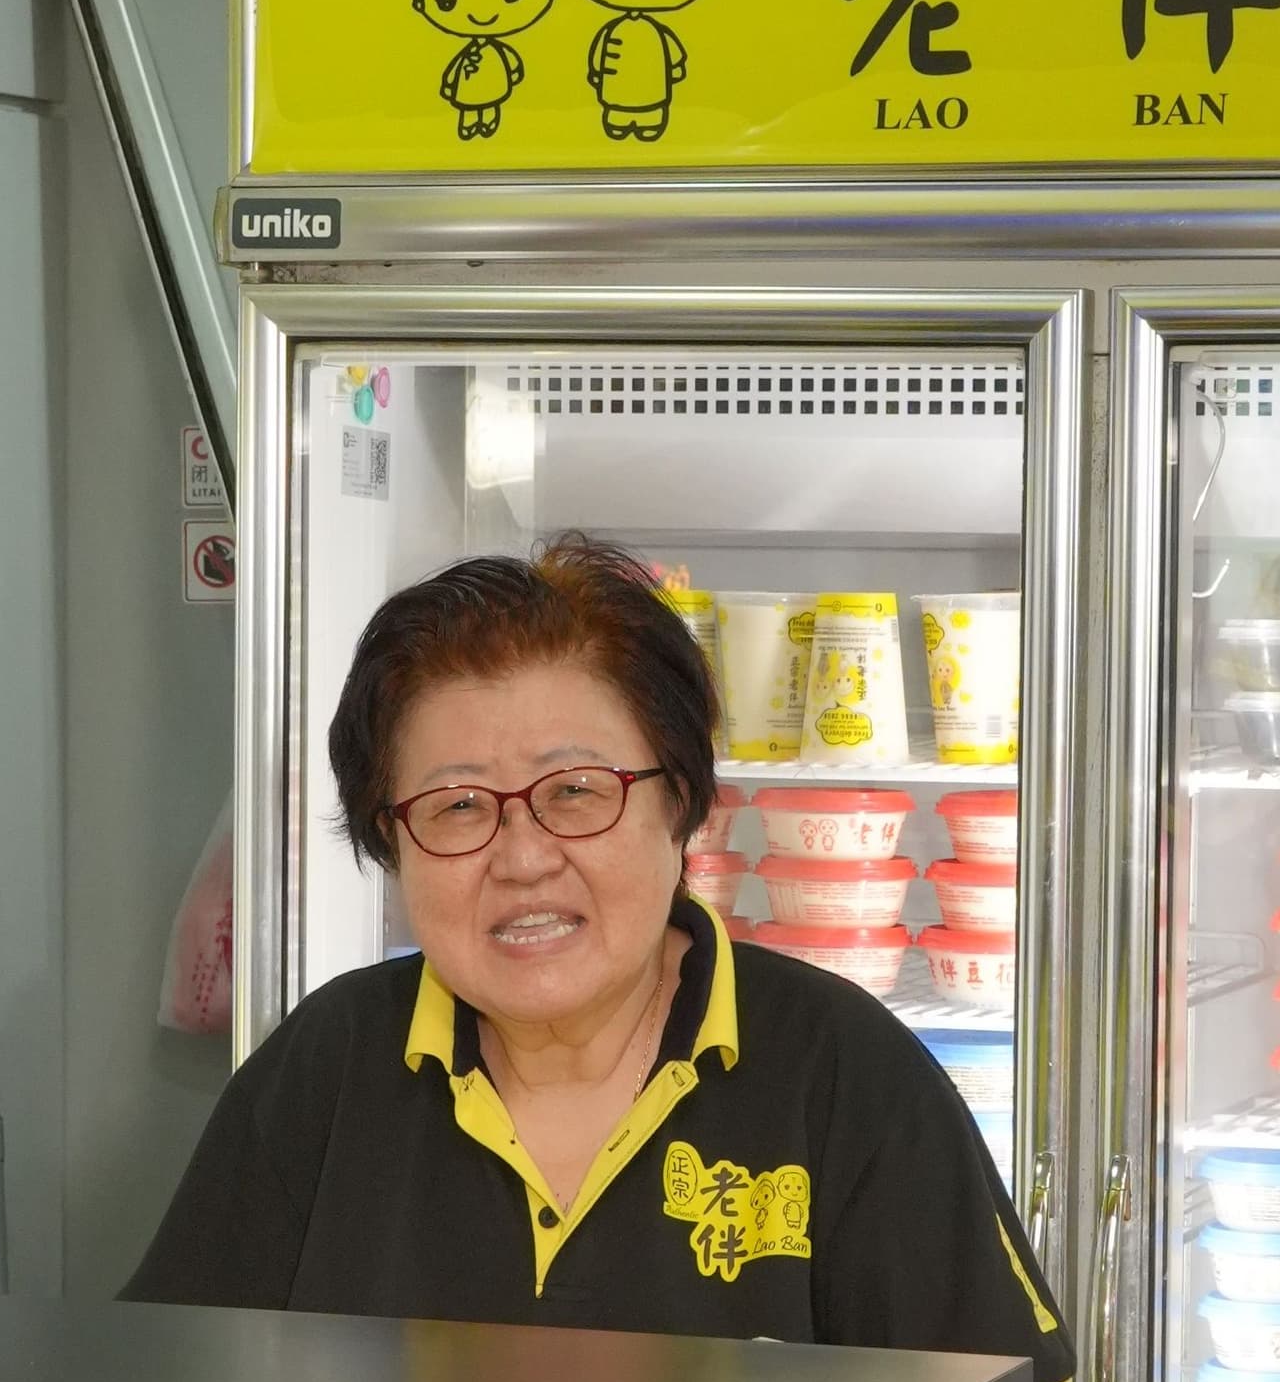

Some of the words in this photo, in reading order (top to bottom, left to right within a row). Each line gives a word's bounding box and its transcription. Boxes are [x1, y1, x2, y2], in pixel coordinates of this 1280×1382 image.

[874, 98, 970, 131] LAO
[1133, 92, 1228, 127] BAN
[241, 210, 332, 239] uniko
[697, 1167, 749, 1275] 老伴
[752, 1237, 776, 1255] Lao
[780, 1235, 808, 1254] Ban
